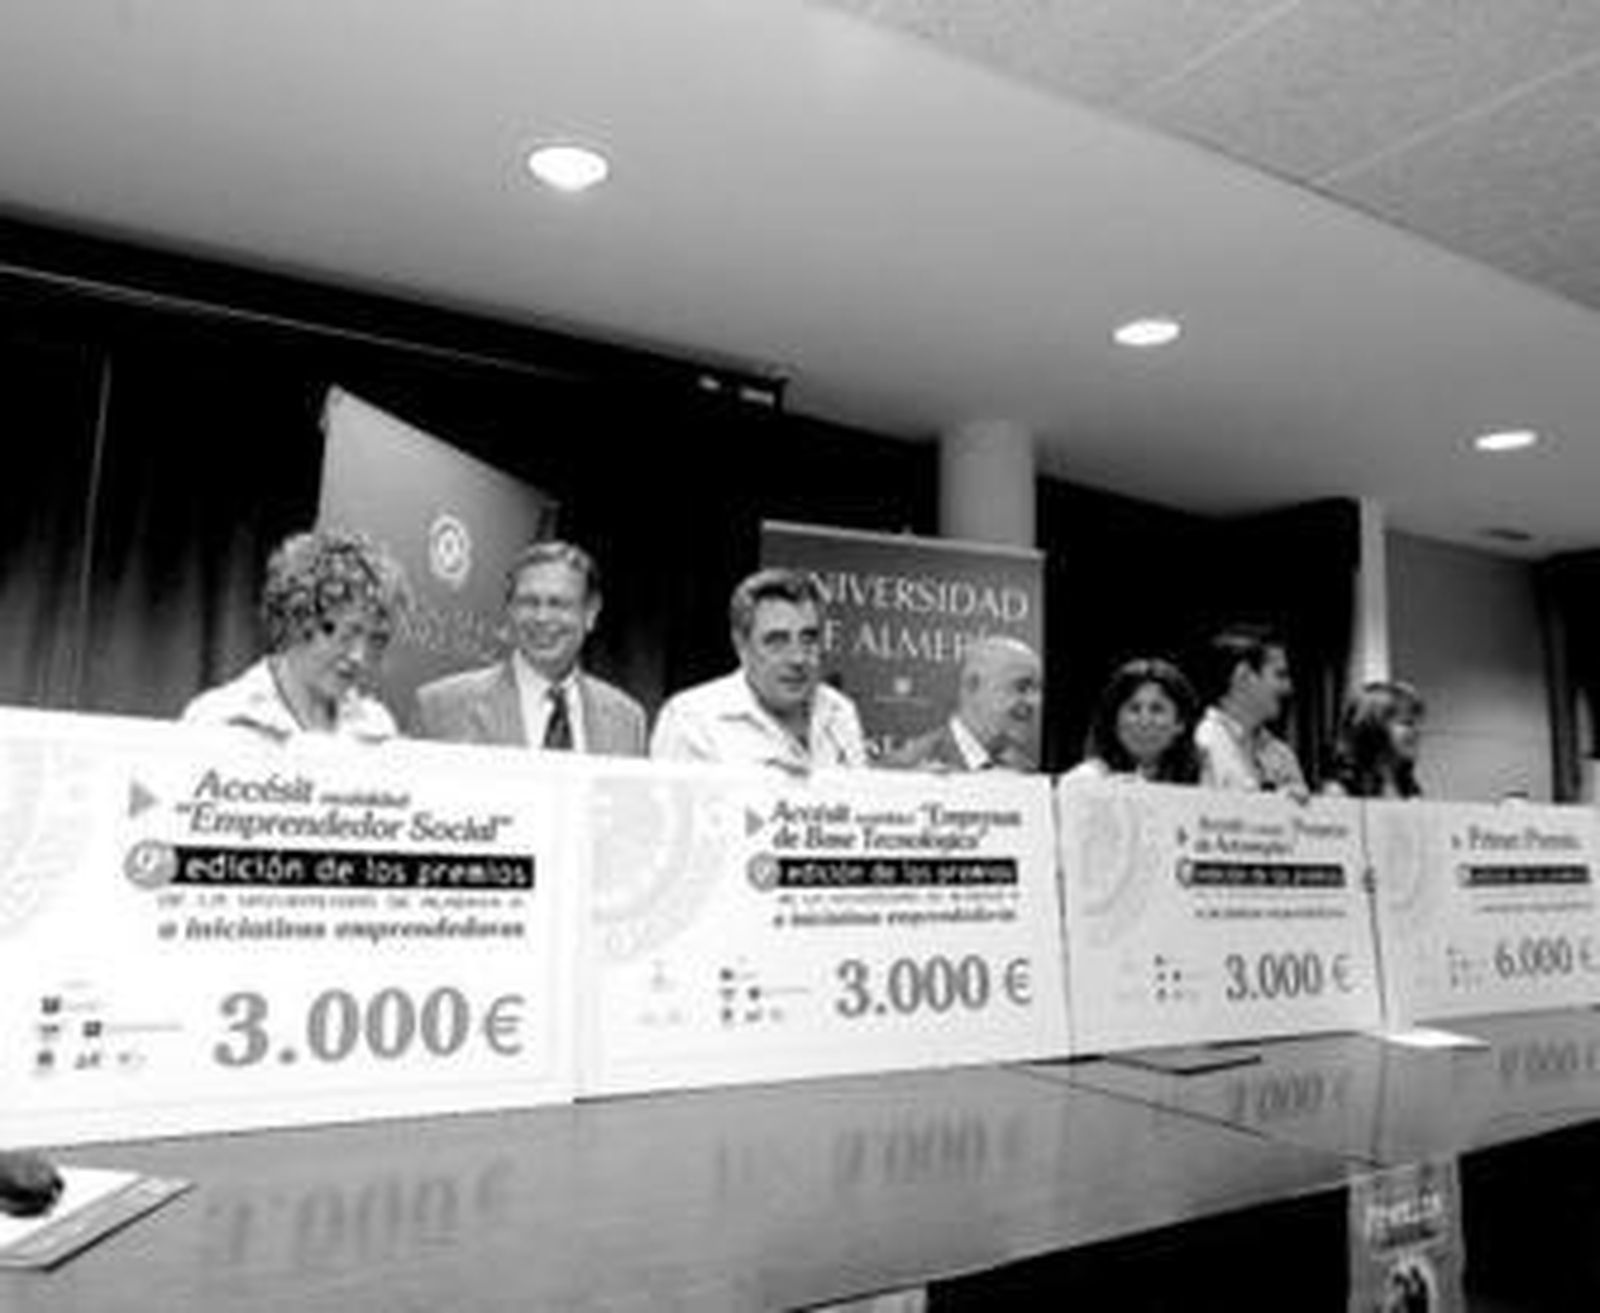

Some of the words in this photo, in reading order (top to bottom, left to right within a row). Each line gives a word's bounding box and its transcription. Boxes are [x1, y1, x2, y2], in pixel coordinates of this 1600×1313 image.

[808, 571, 1029, 622] NIVERSIDAD
[185, 853, 305, 881] edición
[314, 857, 355, 883] de
[363, 856, 408, 885] los
[416, 860, 529, 886] premios
[836, 954, 989, 1018] 3.000
[1225, 952, 1324, 1001] 3.000
[212, 986, 472, 1067] 3.000
